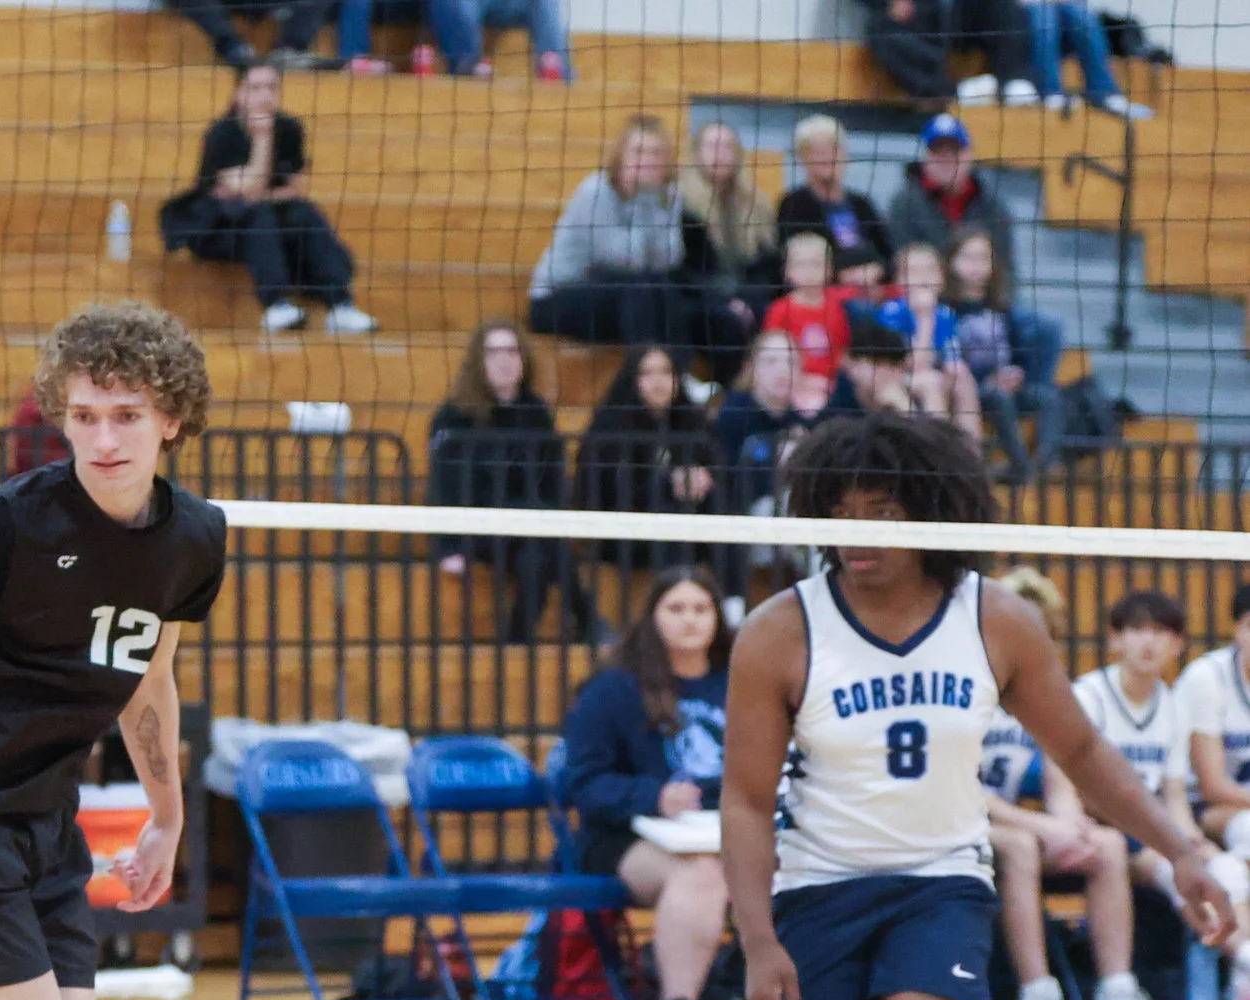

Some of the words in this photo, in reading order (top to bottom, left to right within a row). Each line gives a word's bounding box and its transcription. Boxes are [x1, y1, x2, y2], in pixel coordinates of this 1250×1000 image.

[90, 605, 161, 675] 12
[832, 671, 974, 719] CORSAIRS
[887, 719, 927, 779] 8
